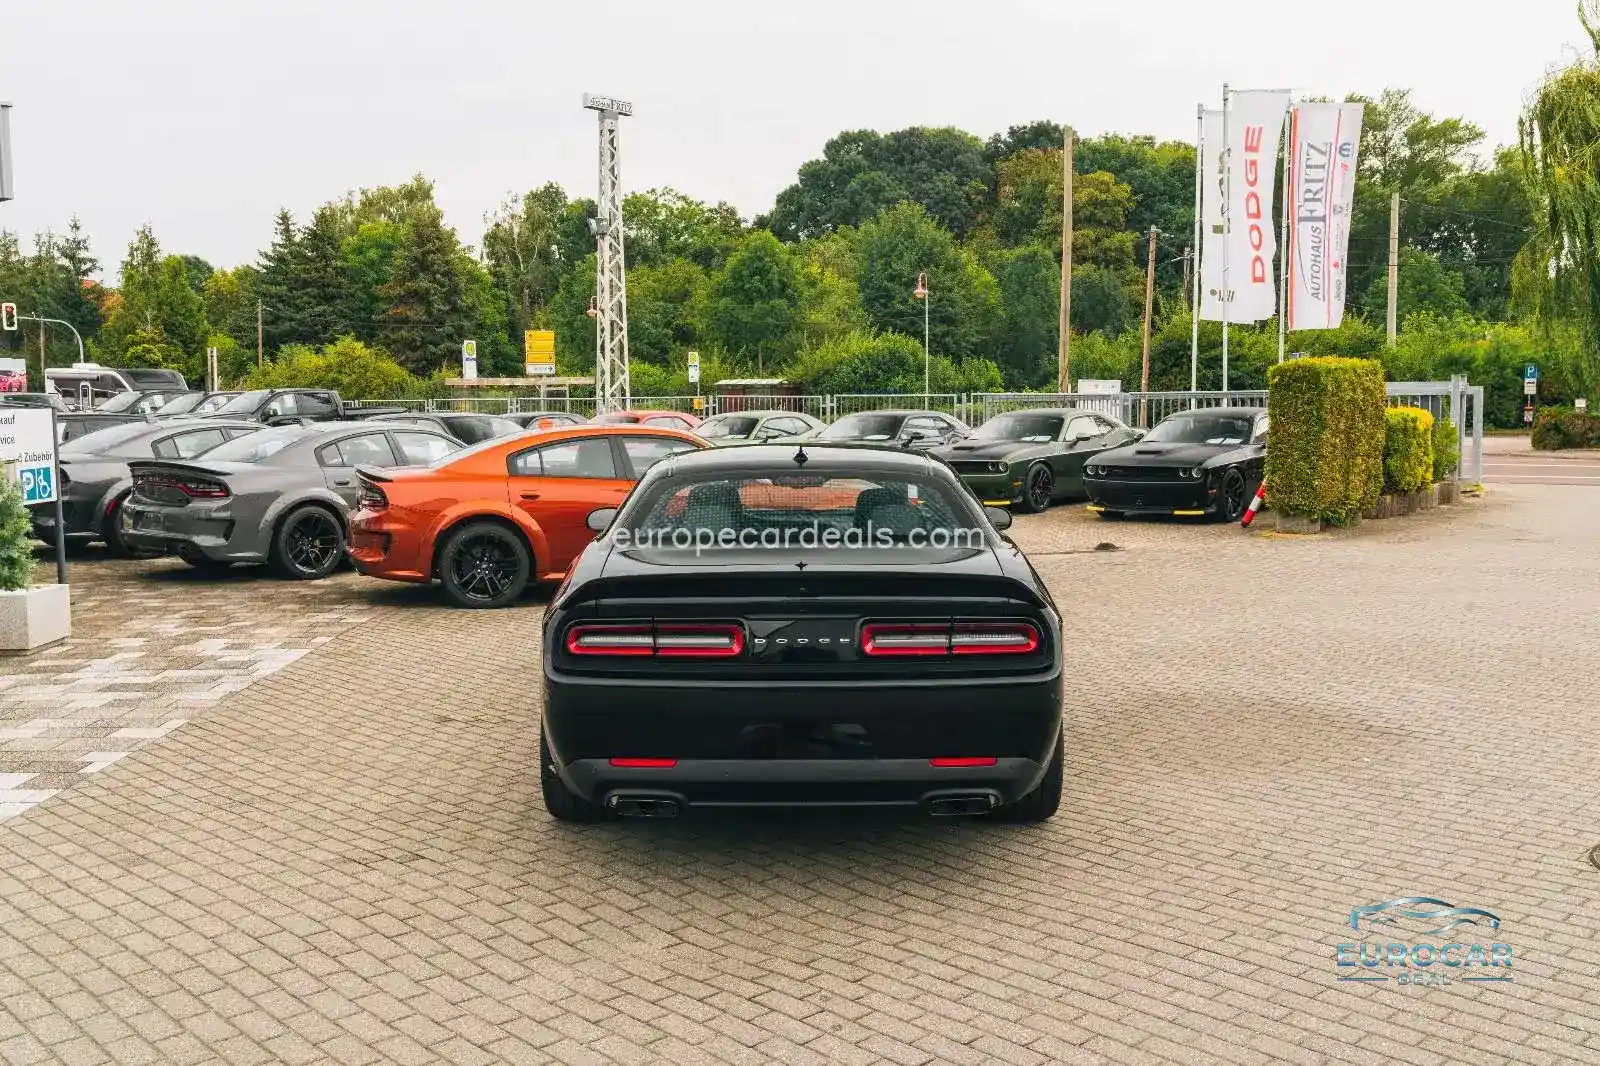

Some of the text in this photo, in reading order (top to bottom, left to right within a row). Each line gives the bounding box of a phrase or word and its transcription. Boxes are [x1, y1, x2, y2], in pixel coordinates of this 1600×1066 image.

[1245, 126, 1265, 283] DODGE
[1298, 142, 1328, 301] AUTOHAUS FRITZ
[24, 452, 53, 463] Zubehör
